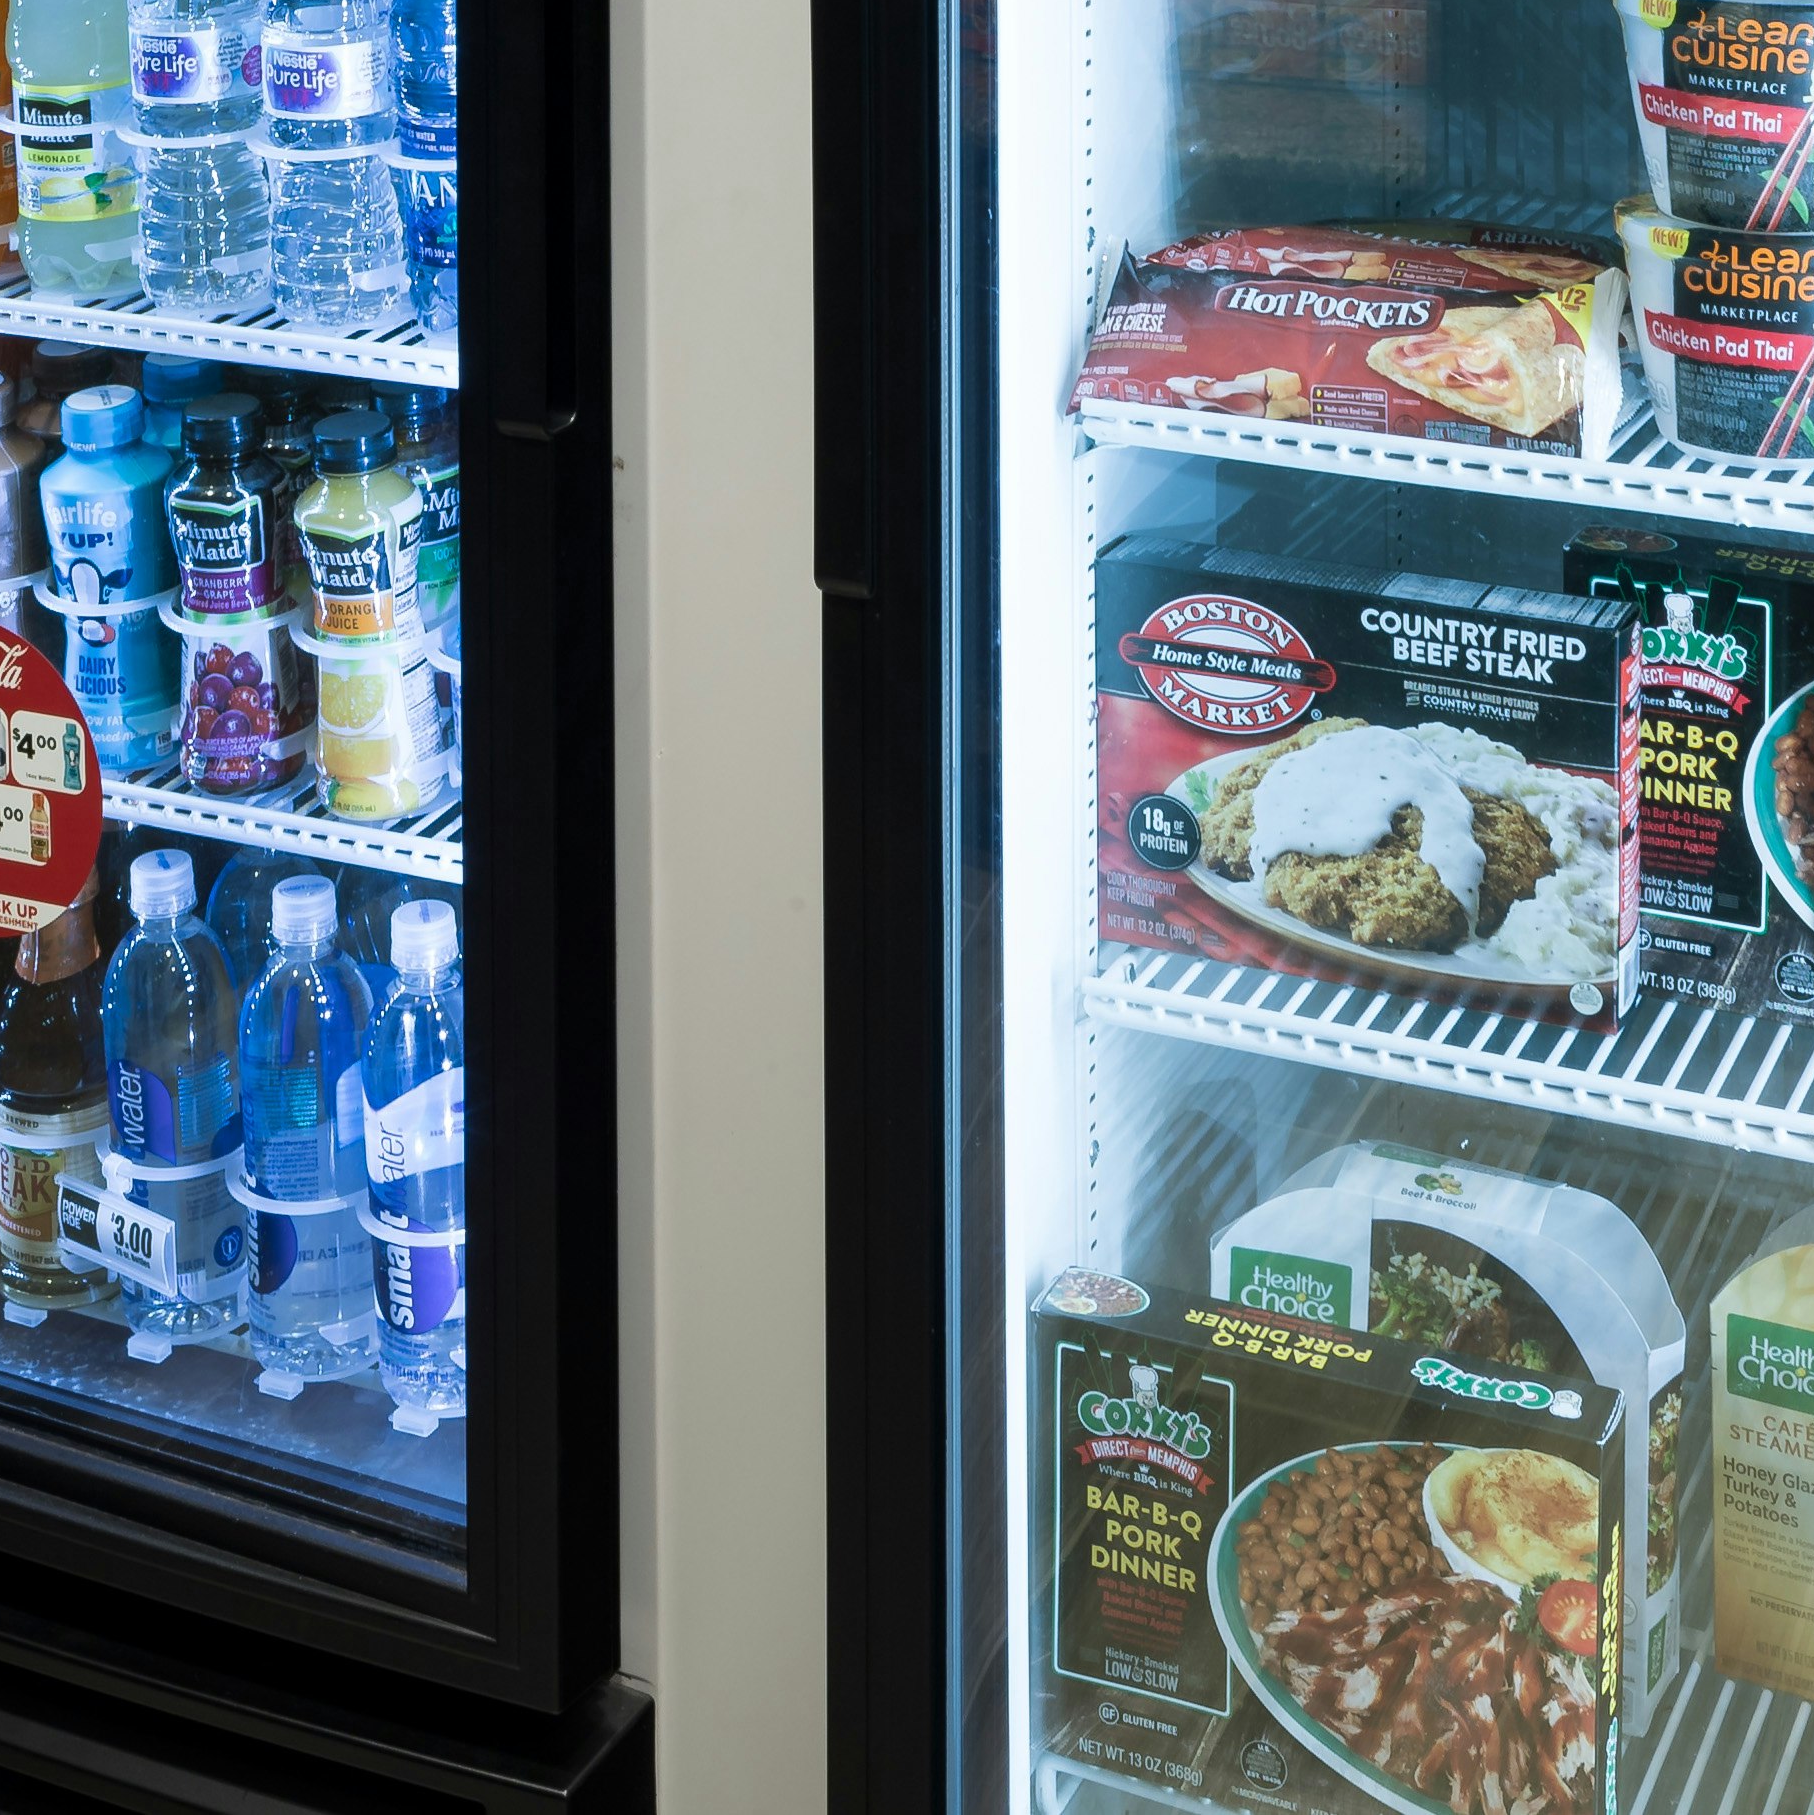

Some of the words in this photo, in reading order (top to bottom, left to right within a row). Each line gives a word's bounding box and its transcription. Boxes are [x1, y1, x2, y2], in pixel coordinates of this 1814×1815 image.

[1717, 19, 1814, 45] Lean
[304, 70, 337, 97] Life
[1688, 74, 1788, 95] MARKETPLACE
[23, 108, 83, 125] Minute
[1645, 93, 1698, 122] Chicken
[1703, 108, 1736, 129] Pad
[1741, 112, 1782, 134] Thai
[28, 153, 81, 163] LEMONADE
[1227, 288, 1292, 316] HOT
[1293, 291, 1431, 328] POCKETS
[1122, 313, 1165, 333] CHEESE
[327, 617, 360, 630] JUICE
[1160, 603, 1294, 649] BOSTON
[1361, 608, 1495, 648] COUNTRY
[1503, 628, 1586, 661] FRIED
[79, 657, 115, 674] DAIRY
[1153, 643, 1202, 666] Home
[1206, 650, 1247, 670] Style
[1251, 655, 1301, 680] Meals
[1393, 637, 1459, 668] BEEF
[1467, 646, 1554, 684] STEAK
[1157, 675, 1292, 726] MARKET
[1140, 832, 1188, 854] PROTEIN
[1107, 886, 1125, 901] KEEP
[1127, 891, 1155, 907] FROZEN
[18, 904, 38, 920] UP
[1107, 913, 1120, 928] NET
[1138, 919, 1153, 934] 13.2
[1170, 924, 1195, 944] (374g)
[62, 1199, 95, 1226] POWER
[1401, 1187, 1422, 1202] Beef
[1425, 1194, 1431, 1203] &
[1433, 1194, 1477, 1211] Broccoli
[1078, 1391, 1211, 1459] CORKY'S
[1147, 1446, 1199, 1480] MEMPHIS
[1721, 1455, 1779, 1482] Honey
[1721, 1475, 1779, 1504] Turkey
[1784, 1491, 1797, 1509] &
[1087, 1486, 1202, 1539] BAR-B-Q
[1723, 1493, 1800, 1528] Potatoes
[1106, 1520, 1183, 1560] PORK
[1090, 1546, 1196, 1592] DINNER
[1122, 1713, 1154, 1730] GLUTEN
[1156, 1720, 1178, 1736] FREE
